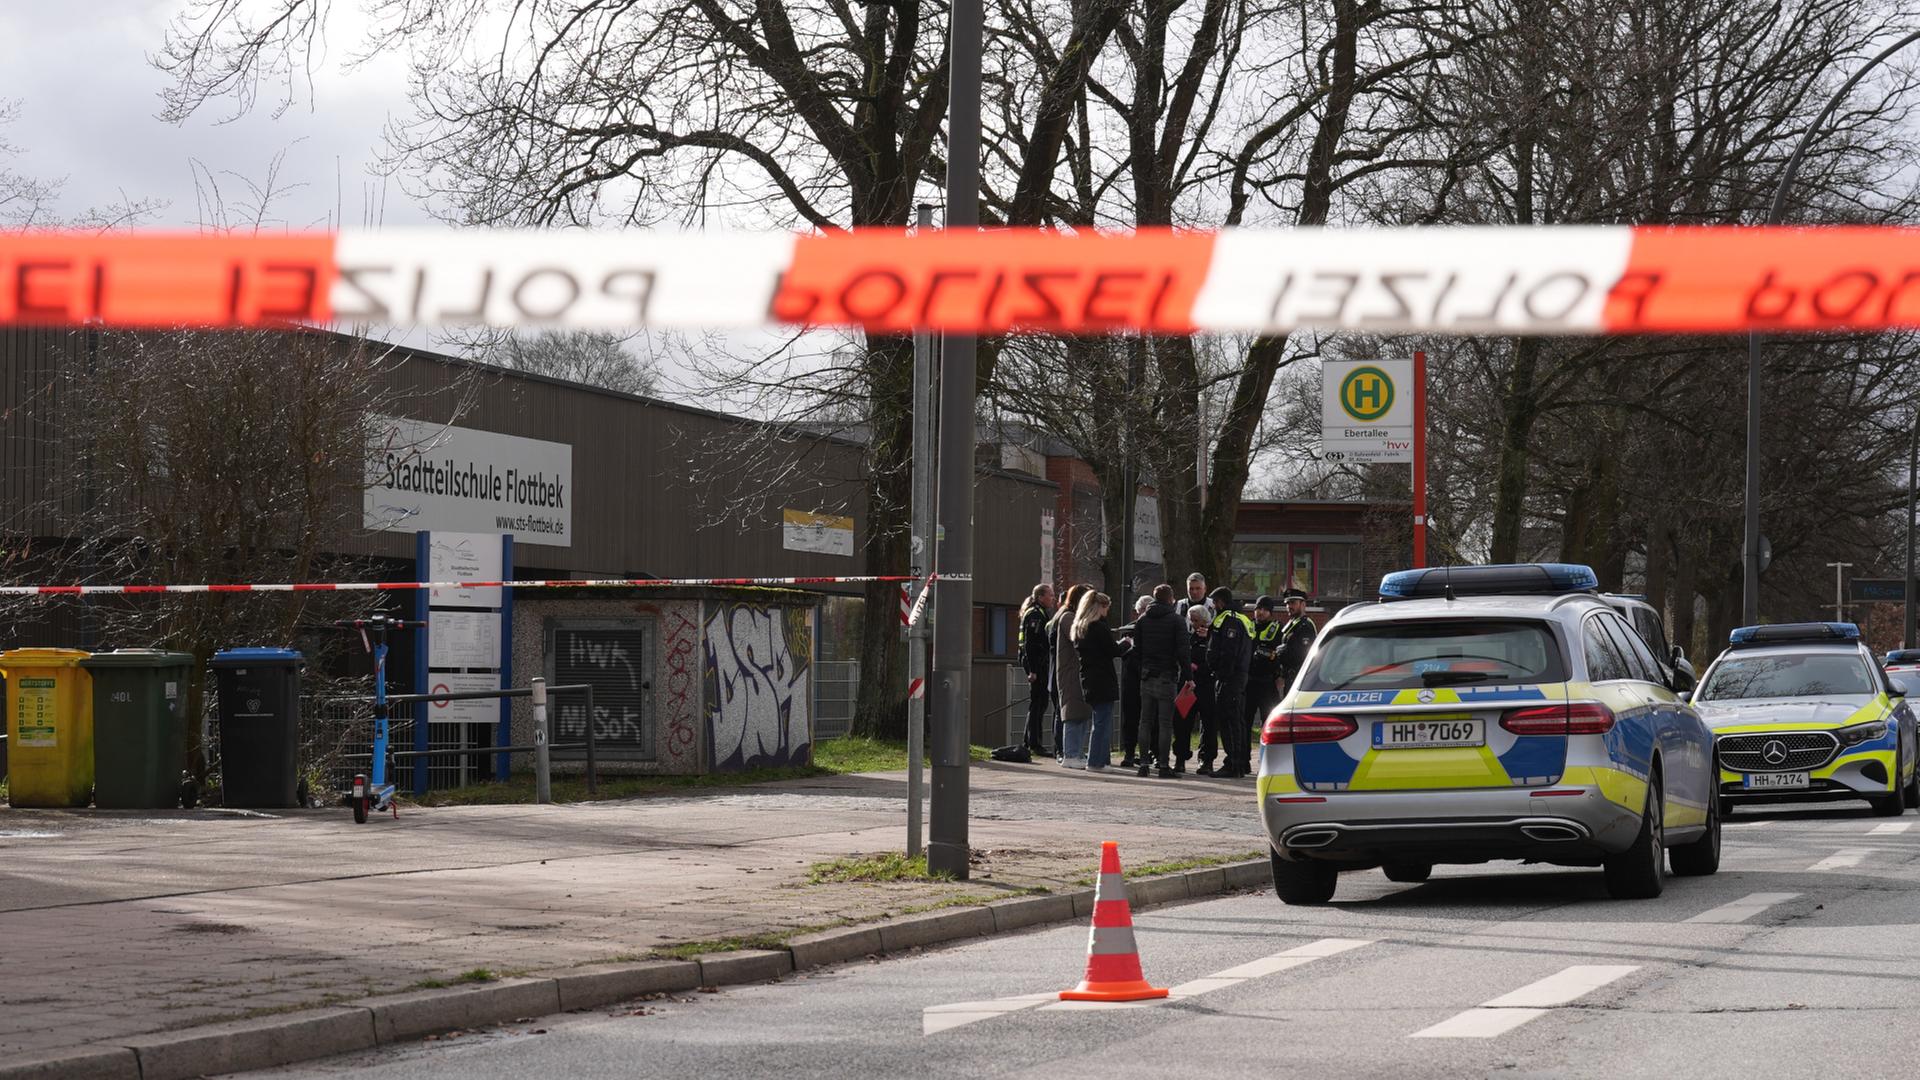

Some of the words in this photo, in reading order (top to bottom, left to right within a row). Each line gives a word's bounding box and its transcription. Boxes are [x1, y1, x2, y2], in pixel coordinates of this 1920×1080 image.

[1354, 379, 1380, 408] H
[1344, 429, 1388, 438] Ebertallee
[1386, 441, 1409, 449] hvv
[386, 453, 502, 501] Stadtteilschule
[506, 468, 564, 509] Flottbek
[496, 515, 564, 535] www.sts-flottbek.de
[1328, 692, 1383, 704] POLIZEI
[1392, 724, 1416, 742] HH
[1428, 722, 1474, 742] 7069
[1754, 775, 1770, 786] HH
[1776, 774, 1803, 785] 7174
